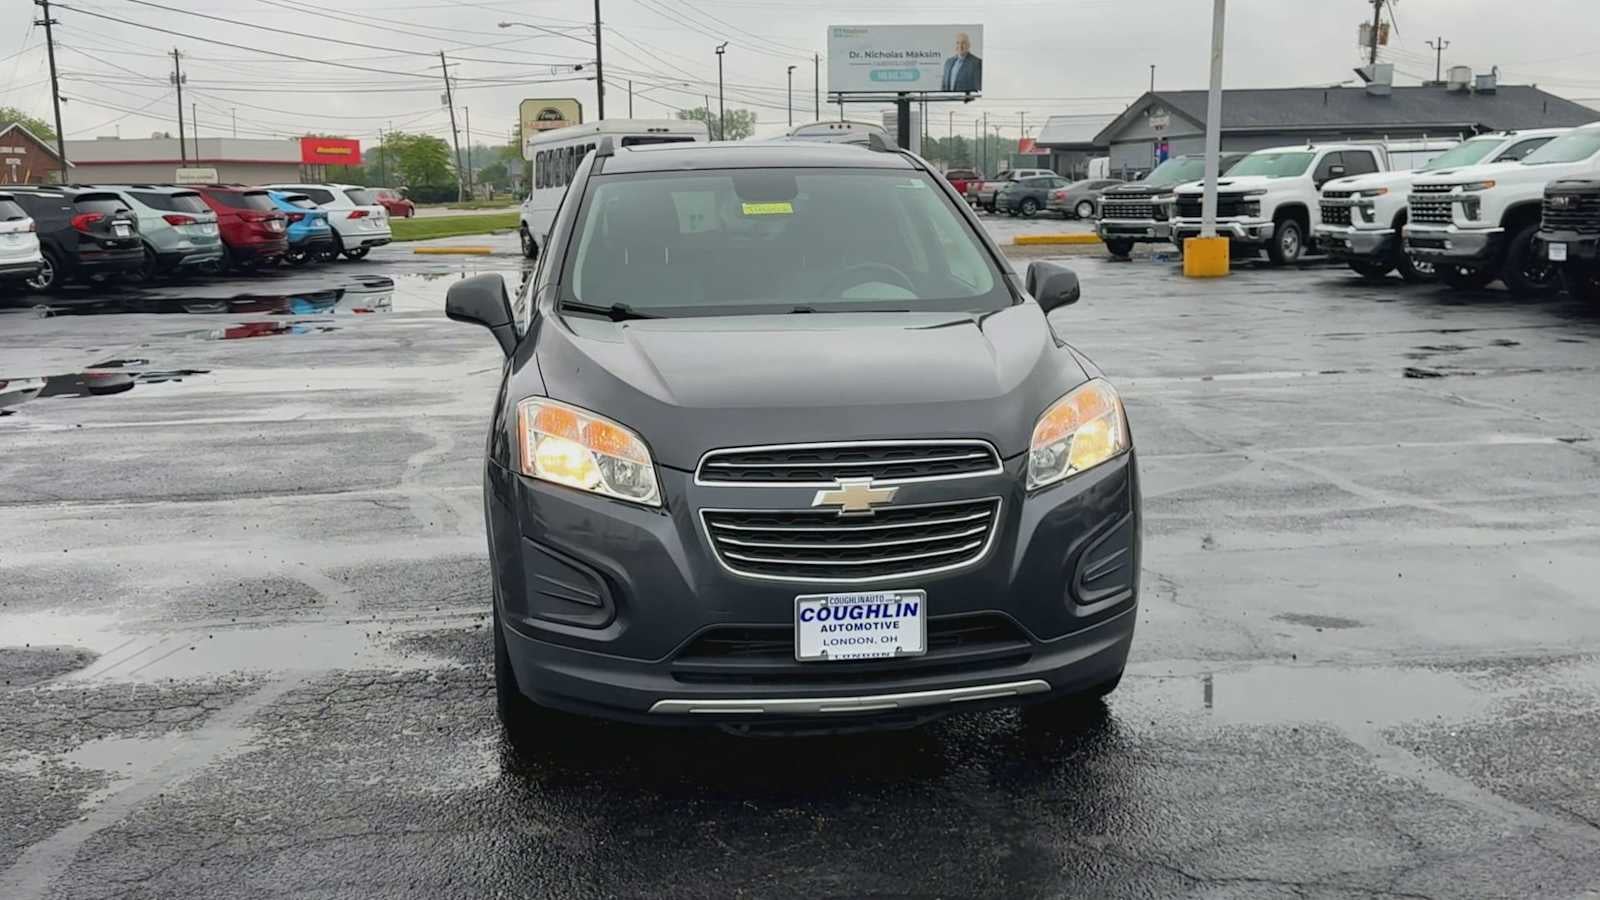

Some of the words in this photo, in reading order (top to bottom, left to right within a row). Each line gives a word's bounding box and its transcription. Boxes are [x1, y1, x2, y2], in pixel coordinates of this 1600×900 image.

[849, 51, 863, 59] Dr.
[865, 50, 903, 58] Nicholas
[906, 50, 941, 58] Maksim
[800, 602, 918, 622] COUGHLIN
[821, 622, 900, 633] AUTOMOTIVE
[881, 635, 898, 643] OH
